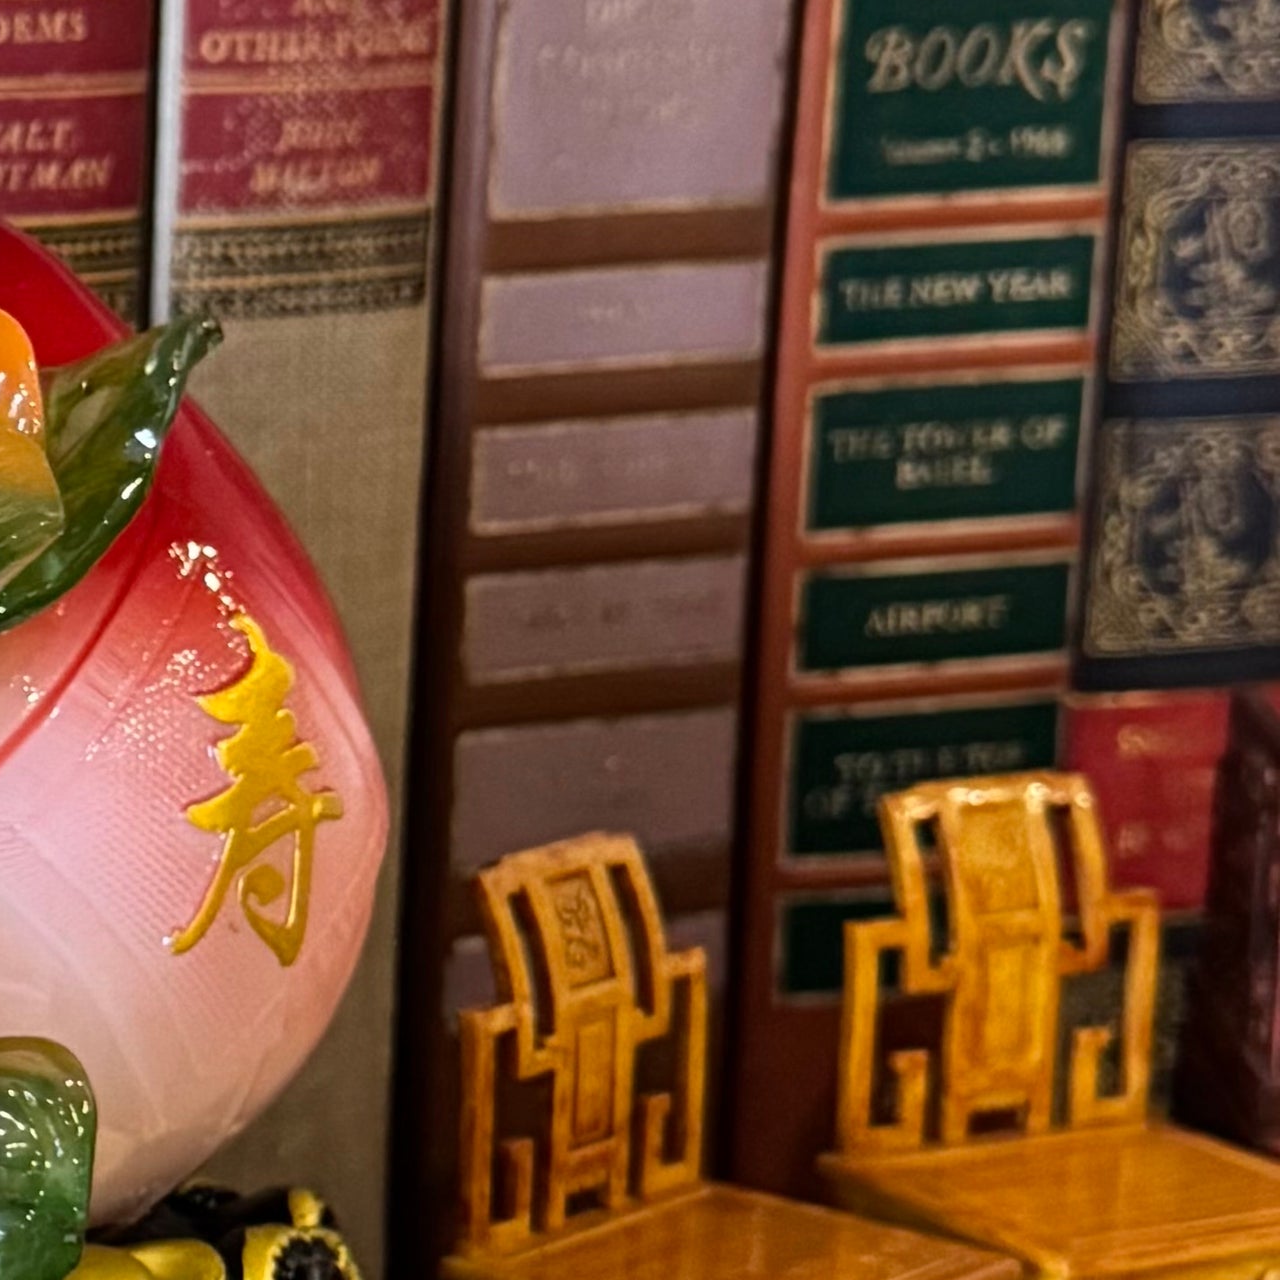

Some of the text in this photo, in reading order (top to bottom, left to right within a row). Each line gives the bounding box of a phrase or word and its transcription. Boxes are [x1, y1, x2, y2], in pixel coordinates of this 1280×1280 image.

[864, 19, 1088, 101] BOOKS
[908, 272, 980, 308] NEW
[987, 268, 1073, 304] YEAR
[171, 612, 344, 967] 寿
